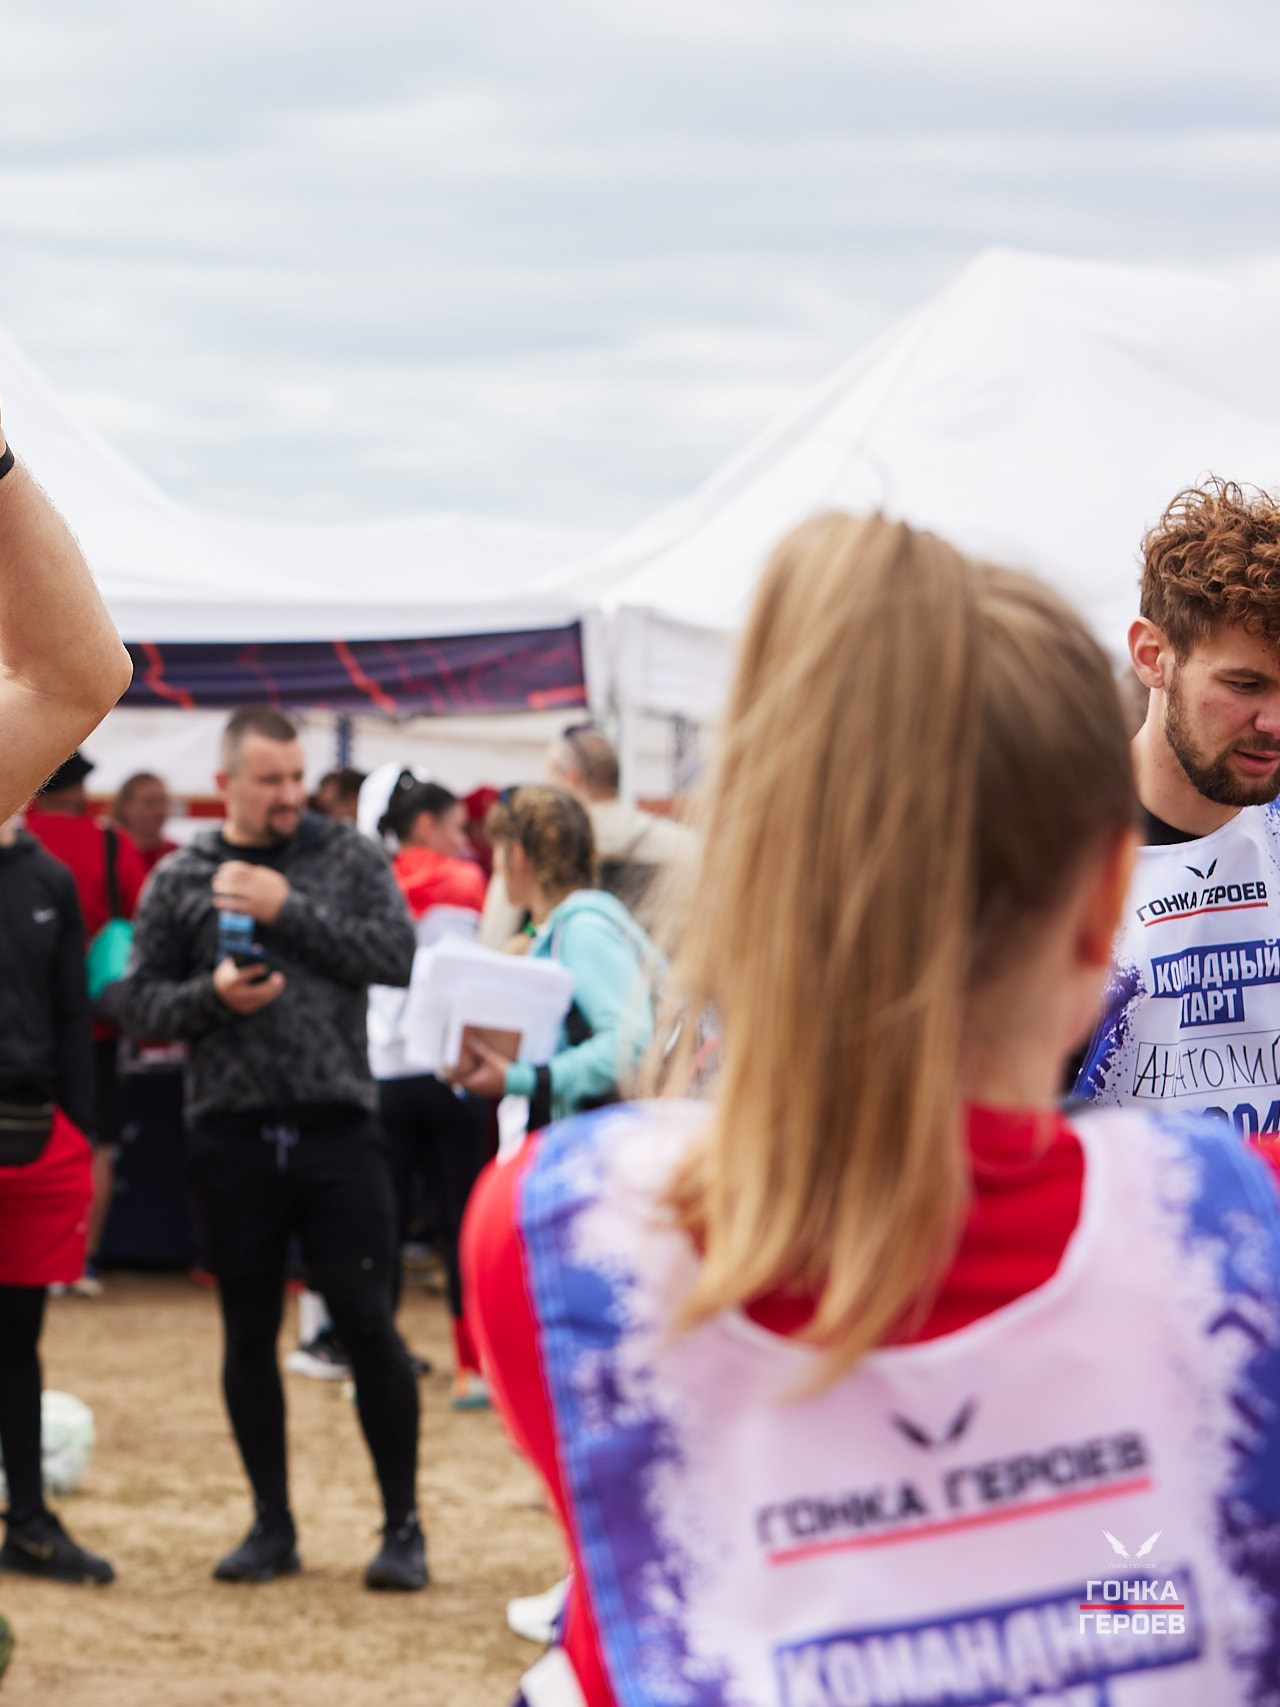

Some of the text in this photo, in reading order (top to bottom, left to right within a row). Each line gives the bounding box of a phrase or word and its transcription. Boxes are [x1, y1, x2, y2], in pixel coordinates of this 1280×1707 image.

[1136, 881, 1268, 922] ГОНКА ГЕРОЕВ
[756, 1431, 1149, 1545] ГОНКА ГЕРОЕВ
